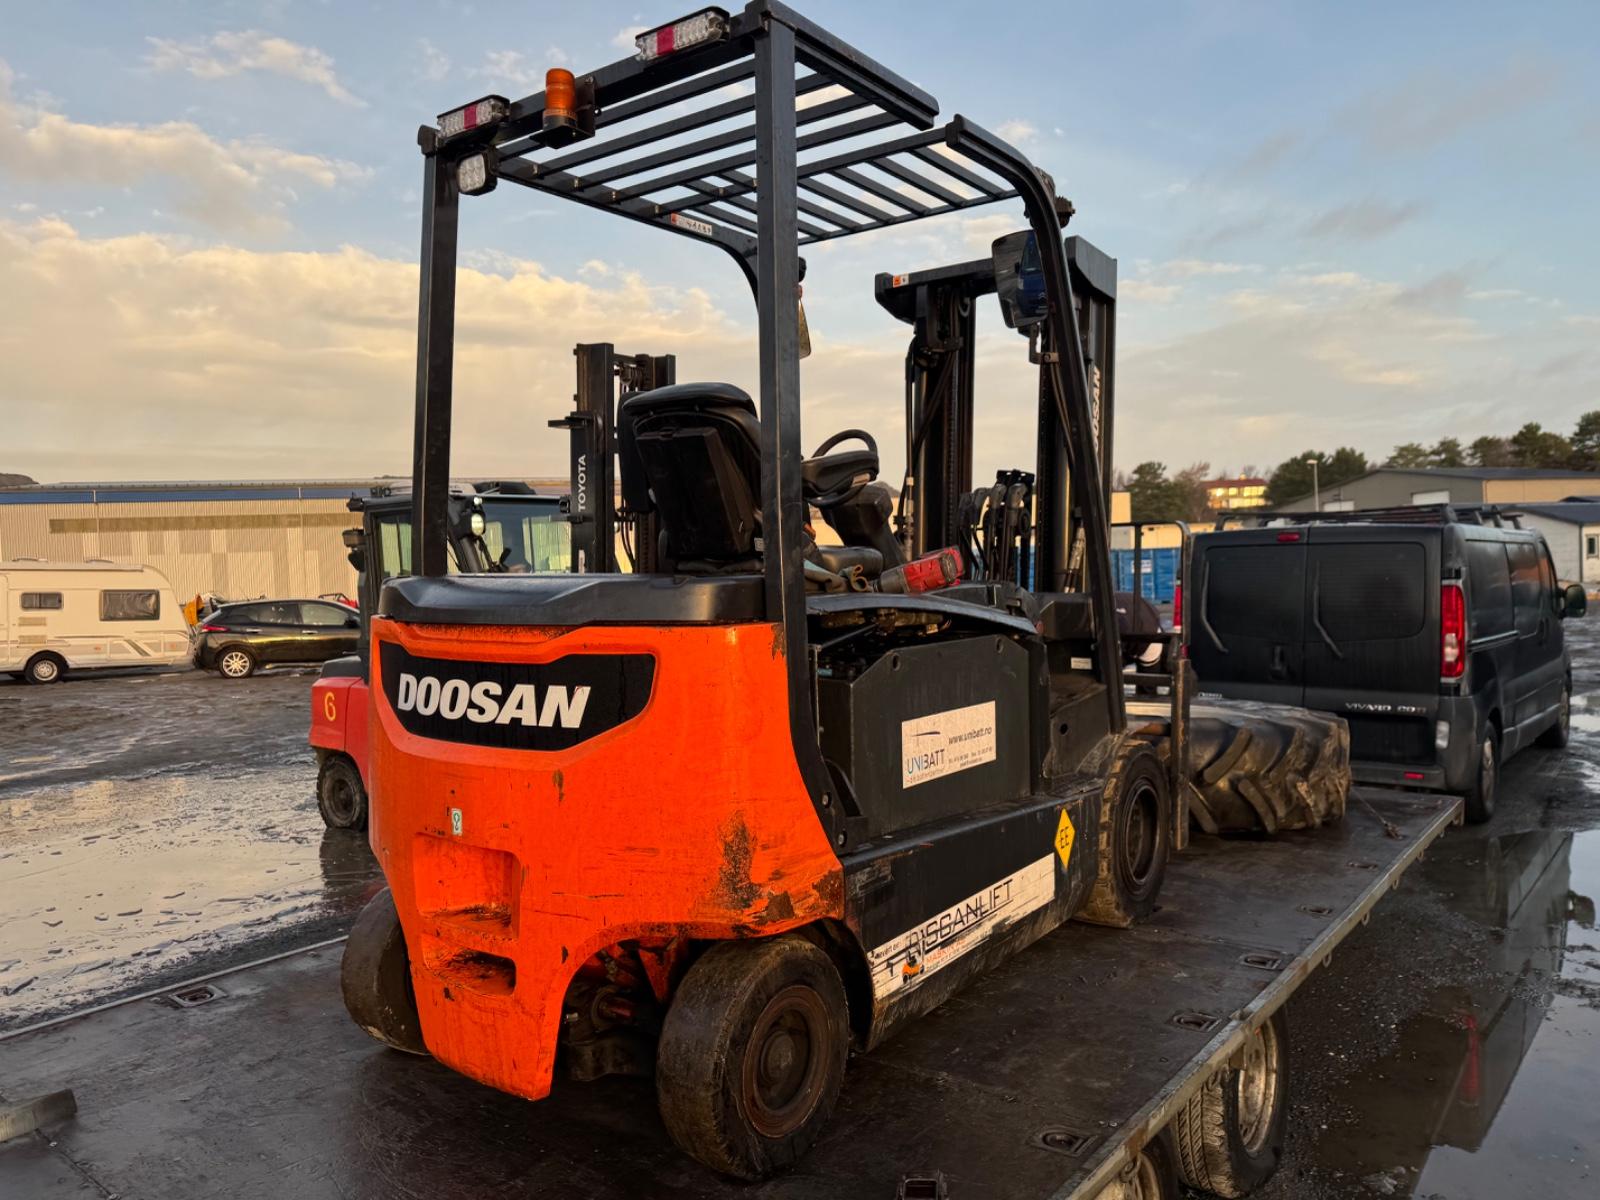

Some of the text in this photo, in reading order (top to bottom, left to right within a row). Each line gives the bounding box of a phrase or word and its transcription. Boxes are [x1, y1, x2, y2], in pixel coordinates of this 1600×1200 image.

[577, 454, 586, 512] TOYOTA
[324, 691, 336, 721] 6
[397, 672, 592, 729] DOOSAN
[948, 726, 992, 746] www.unibatt.no
[906, 748, 945, 775] UNIBATT
[1059, 826, 1070, 849] EE
